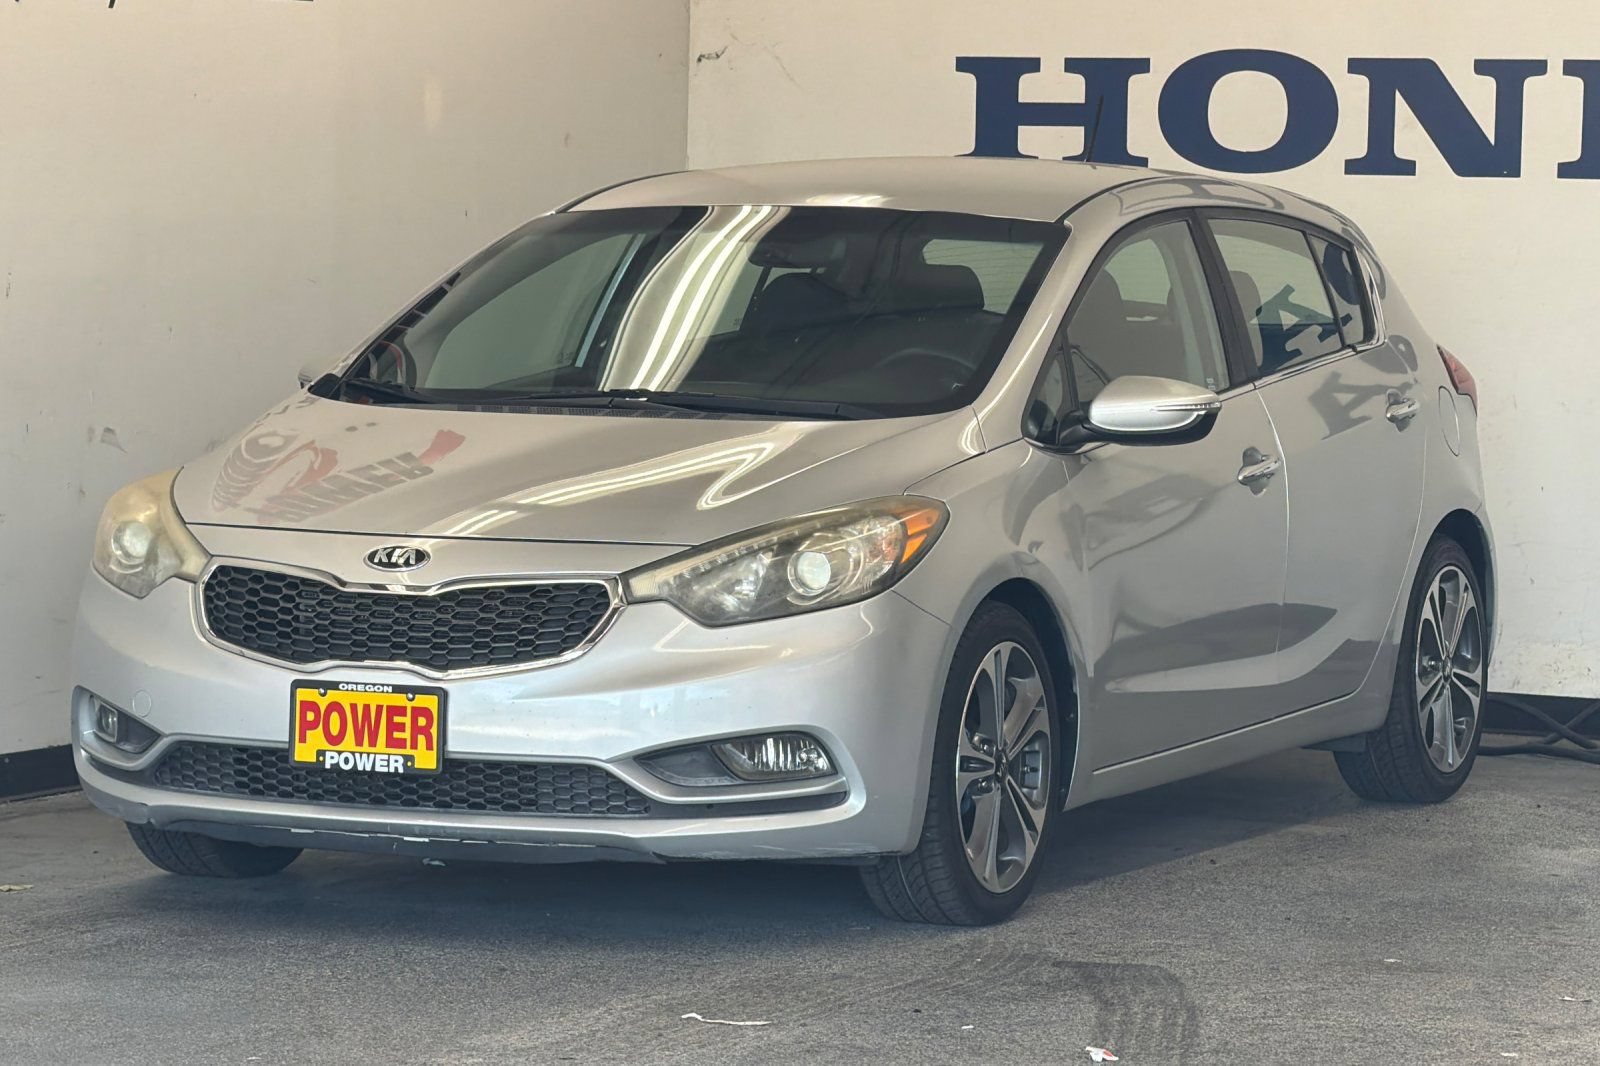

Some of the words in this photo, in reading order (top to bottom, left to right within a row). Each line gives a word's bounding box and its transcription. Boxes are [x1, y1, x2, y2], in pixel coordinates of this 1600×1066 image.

[954, 48, 1600, 180] HON
[373, 547, 416, 565] KIA
[338, 683, 393, 694] OREGON
[298, 700, 435, 751] POWER
[324, 751, 405, 773] POWER
